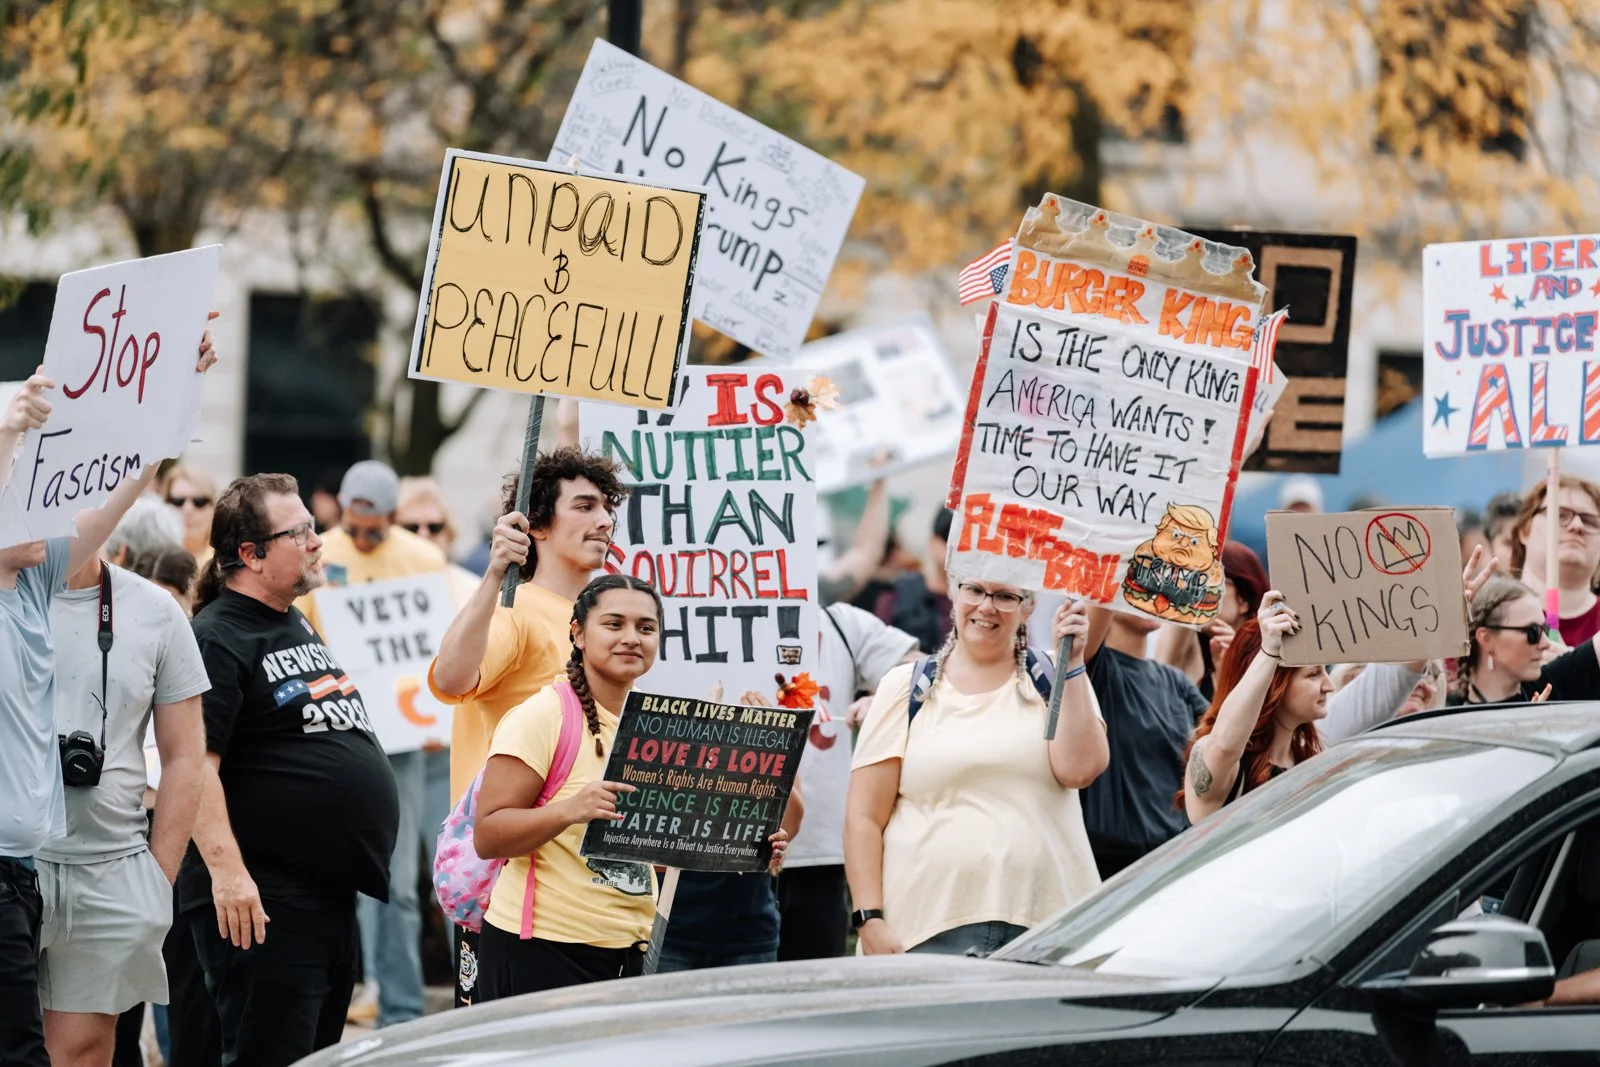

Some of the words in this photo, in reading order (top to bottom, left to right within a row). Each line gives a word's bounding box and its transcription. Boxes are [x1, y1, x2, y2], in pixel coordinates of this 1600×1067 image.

[622, 94, 684, 168] No
[702, 141, 808, 230] Kings
[1480, 238, 1600, 278] LIBER
[1006, 250, 1149, 324] BURGER
[1158, 287, 1255, 351] KING
[1529, 275, 1583, 300] AND
[63, 284, 160, 404] Stop
[1435, 309, 1599, 361] JUSTICE
[1009, 319, 1042, 363] IS
[1056, 327, 1108, 374] THE
[1122, 344, 1181, 390] ONLY
[1185, 360, 1240, 404] KING
[706, 373, 784, 426] IS
[986, 369, 1096, 428] AMERICA
[27, 428, 140, 512] Fascism
[602, 425, 813, 482] NUTTIER
[977, 422, 1033, 461] TIME
[1047, 430, 1078, 463] TO
[1083, 432, 1142, 476] HAVE
[1148, 453, 1198, 484] IT
[624, 483, 795, 546] THAN
[1012, 465, 1084, 507] OUR
[1096, 483, 1156, 524] WAY
[1137, 555, 1208, 596] TRUMP
[1295, 526, 1362, 594] NO
[101, 603, 110, 622] EOS
[346, 588, 431, 625] VETO
[1311, 582, 1440, 653] KINGS
[367, 631, 434, 665] THE
[659, 605, 800, 664] HIT!
[262, 642, 339, 683] NEWSO
[302, 698, 374, 734] 2028
[634, 715, 662, 734] NO
[665, 718, 724, 742] HUMAN
[727, 725, 740, 744] IS
[743, 727, 791, 750] ILLEGAL
[641, 696, 691, 716] BLACK
[694, 703, 736, 721] LIVES
[739, 707, 797, 728] MATTER
[627, 737, 690, 767] LOVE
[696, 745, 720, 770] IS
[727, 749, 786, 776] LOVE
[616, 787, 696, 813] SCIENCE
[704, 796, 721, 816] IS
[728, 799, 768, 820] REAL
[622, 763, 664, 785] Women's
[665, 769, 695, 790] Rights
[696, 773, 713, 790] Are
[715, 775, 747, 794] Human
[749, 779, 776, 799] Rights
[603, 831, 630, 845] Injustice
[630, 834, 661, 848] Anywhere
[676, 839, 696, 852] Threat
[704, 842, 724, 855] Justice
[724, 843, 758, 857] Everywhere
[609, 810, 681, 835] WATER
[691, 819, 712, 838] IS
[722, 822, 765, 842] LIFE
